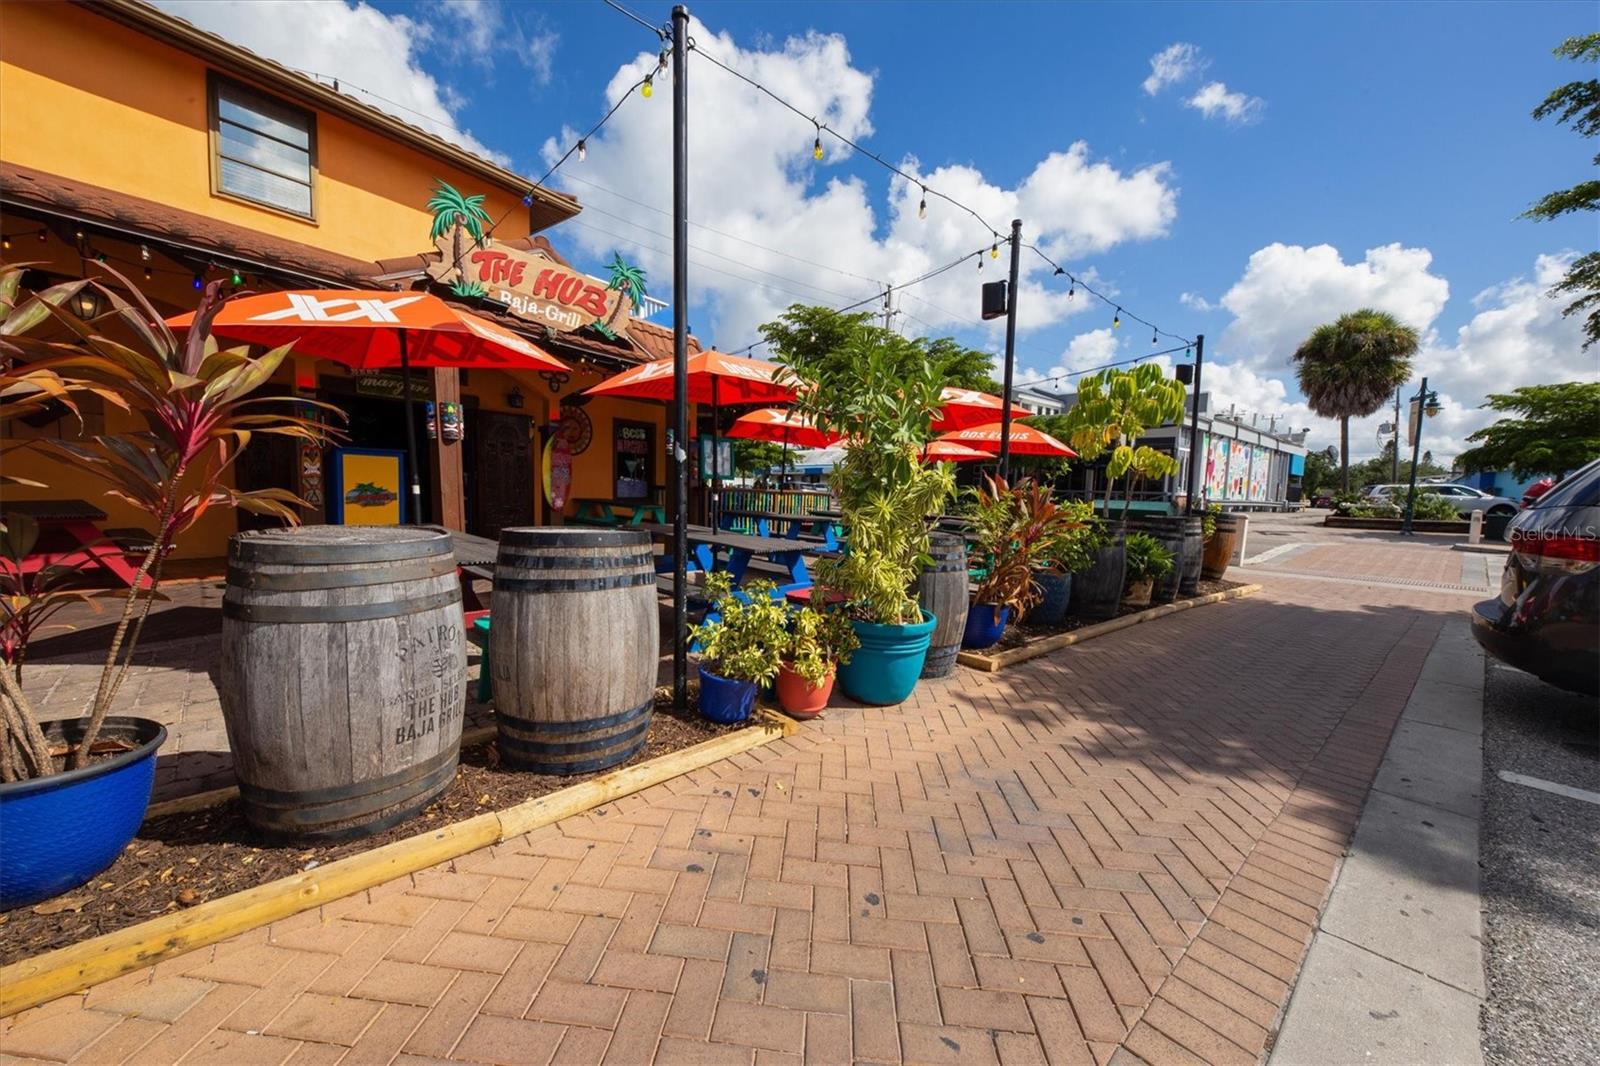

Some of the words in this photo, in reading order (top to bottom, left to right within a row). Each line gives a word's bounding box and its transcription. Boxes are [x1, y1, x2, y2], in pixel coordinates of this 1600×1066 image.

[471, 251, 528, 287] THE
[533, 268, 608, 318] HUB
[959, 431, 985, 440] DOS
[395, 716, 435, 745] BAJA
[438, 699, 461, 728] GRILL
[407, 696, 435, 720] THE
[440, 684, 459, 709] HUB
